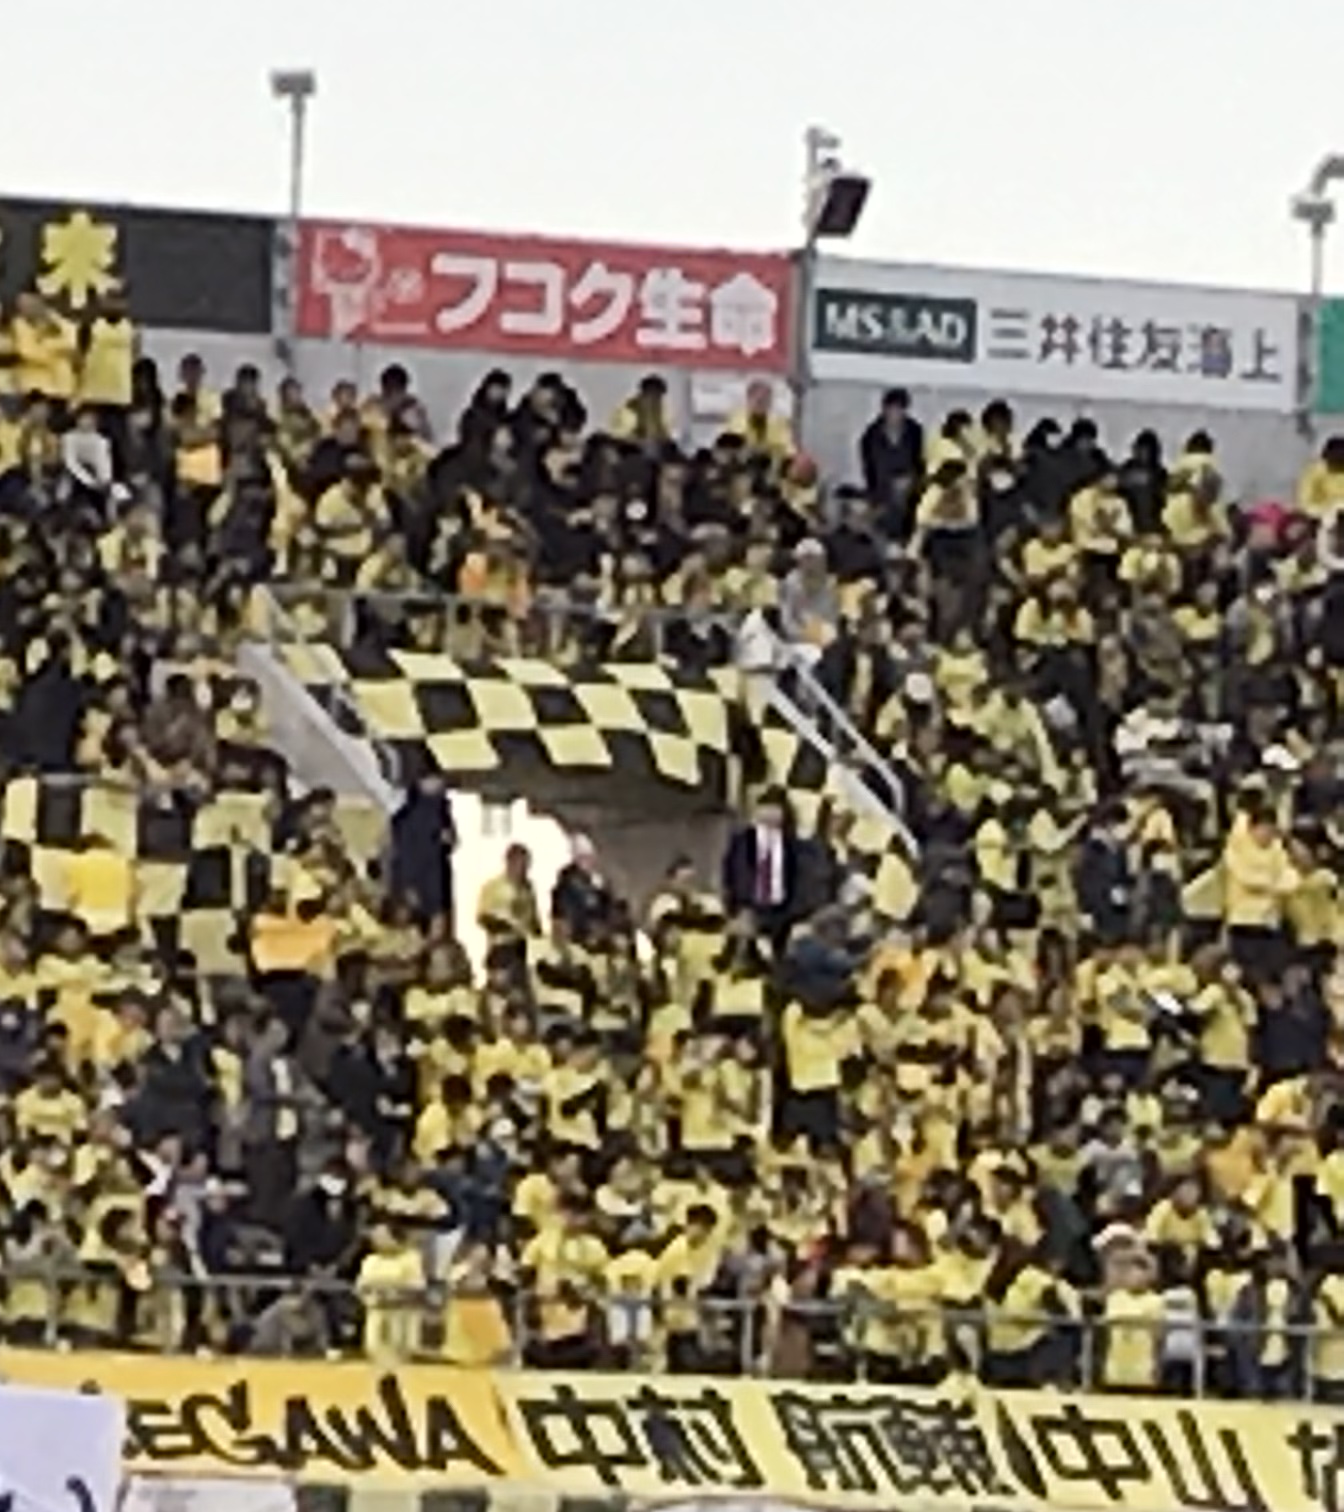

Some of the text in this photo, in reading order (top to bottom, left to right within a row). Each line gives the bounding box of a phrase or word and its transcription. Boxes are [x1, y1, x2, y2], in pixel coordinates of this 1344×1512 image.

[431, 252, 778, 356] フコク生命
[987, 308, 1283, 384] 三井住友海上
[75, 1373, 507, 1477] EGAWA
